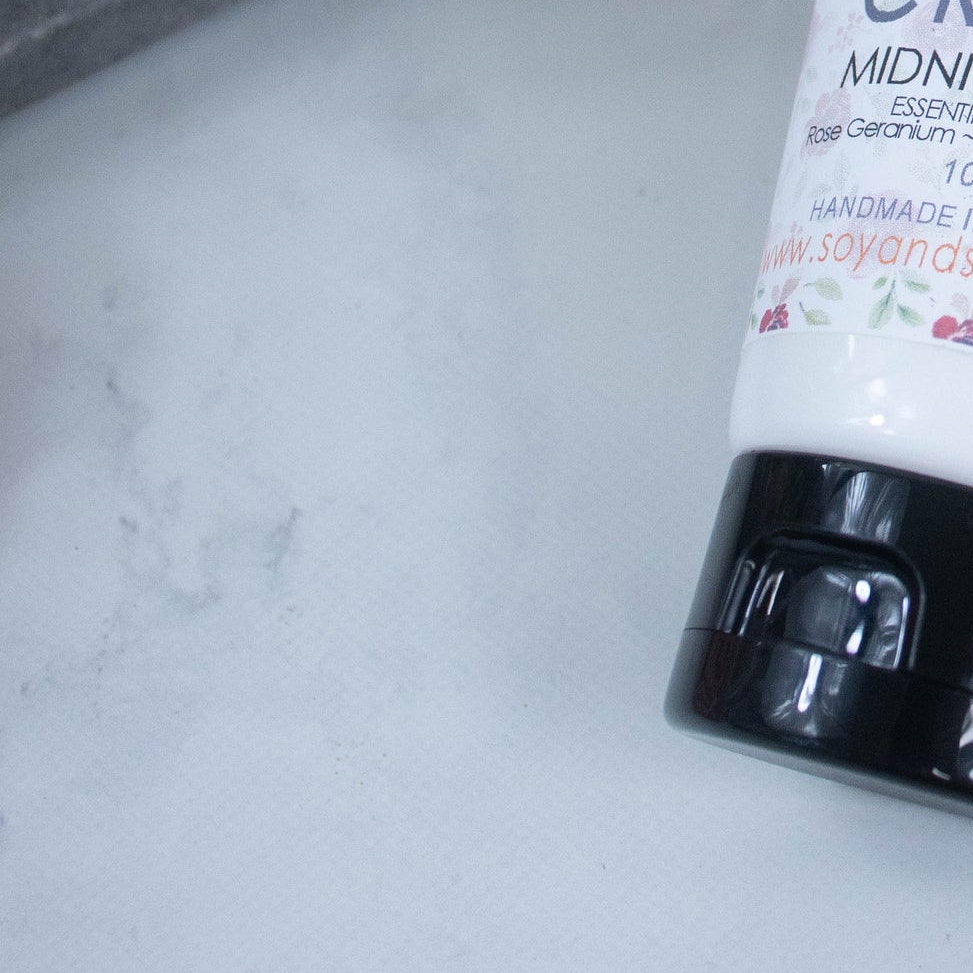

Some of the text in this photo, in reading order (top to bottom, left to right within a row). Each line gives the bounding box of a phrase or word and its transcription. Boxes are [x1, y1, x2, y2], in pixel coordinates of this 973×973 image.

[806, 124, 843, 147] Rose
[846, 117, 957, 145] Geranium
[808, 195, 956, 228] HANDMADE
